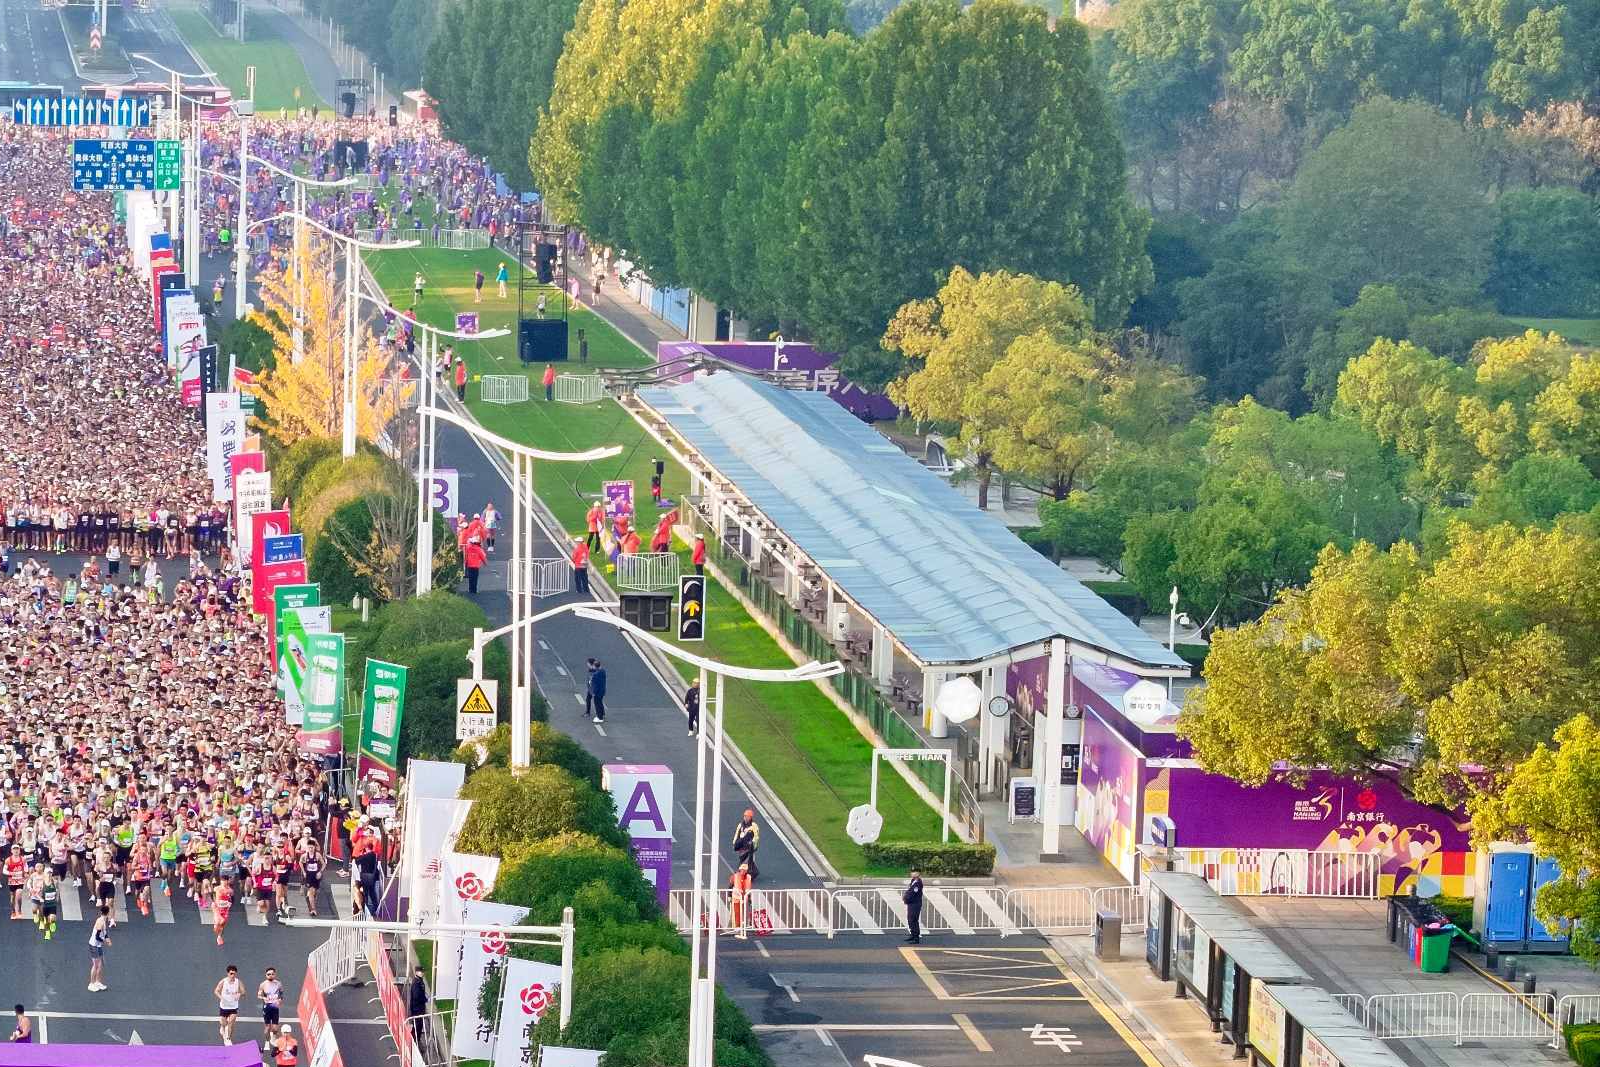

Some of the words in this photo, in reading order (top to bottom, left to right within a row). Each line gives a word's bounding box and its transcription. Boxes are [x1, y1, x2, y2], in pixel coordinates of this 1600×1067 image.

[620, 781, 667, 831] A
[1346, 812, 1385, 822] 南京银行
